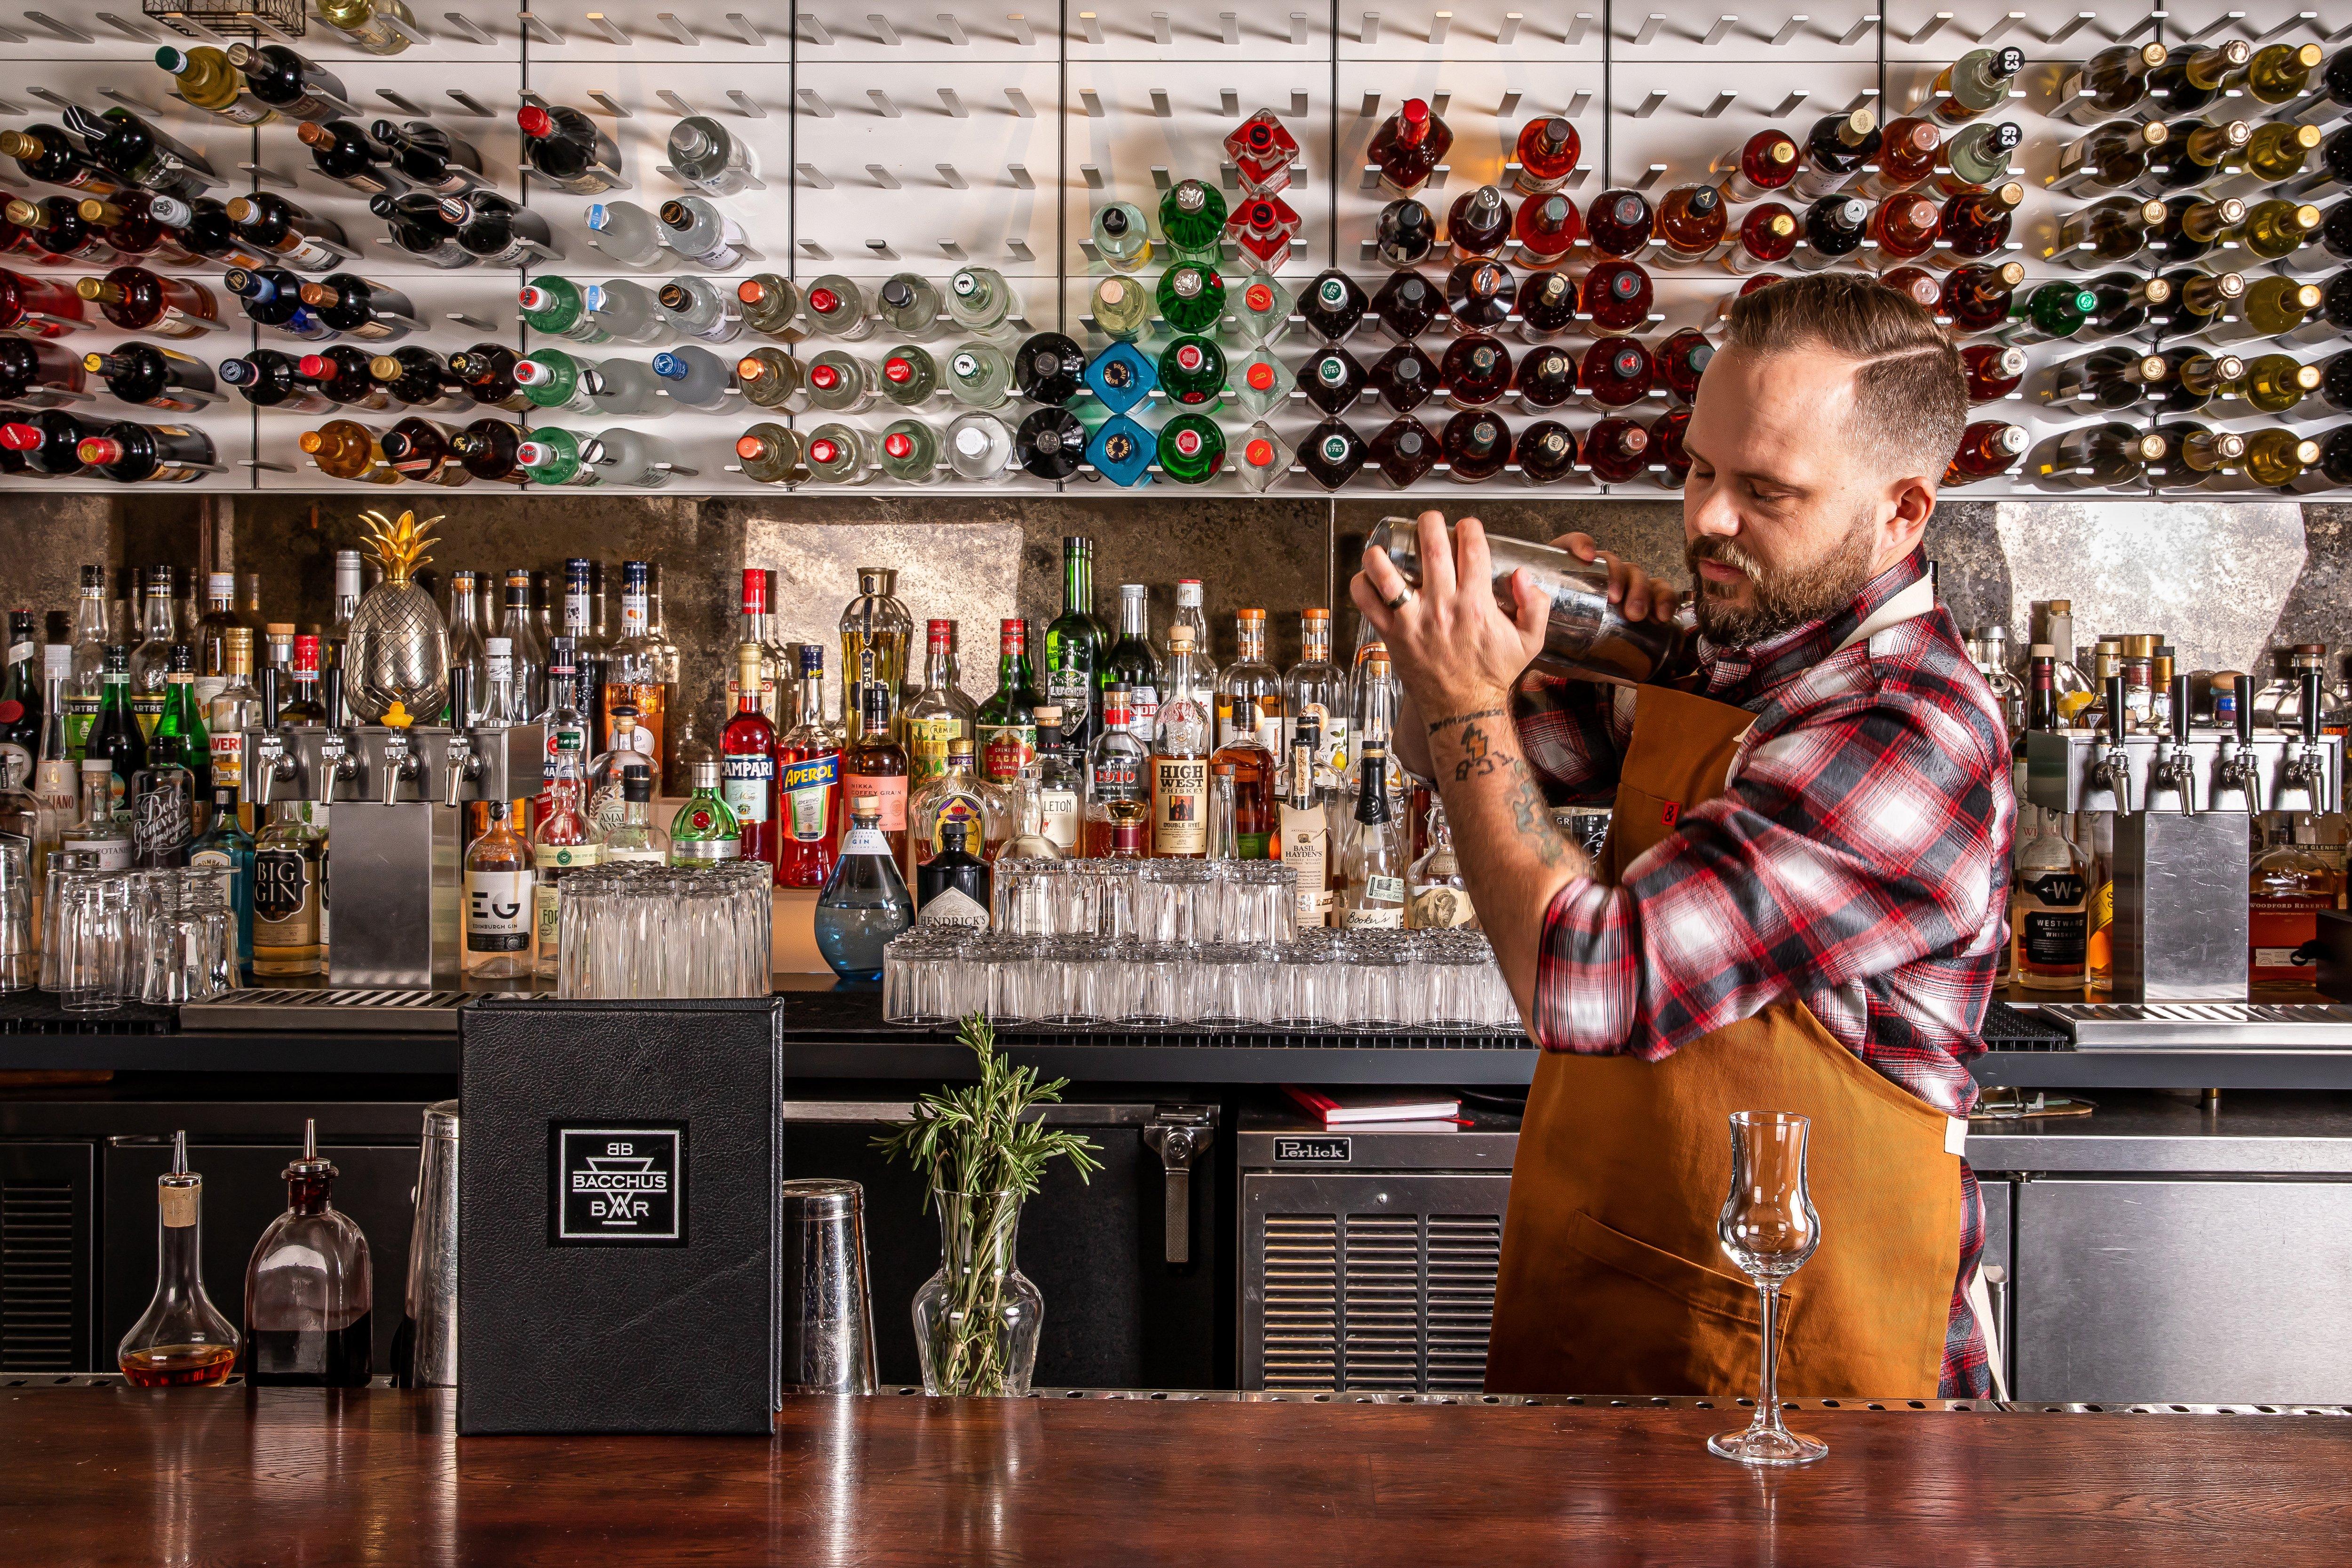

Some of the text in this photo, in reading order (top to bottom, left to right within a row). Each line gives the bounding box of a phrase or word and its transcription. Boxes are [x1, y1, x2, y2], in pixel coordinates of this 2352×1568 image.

[2004, 51, 2019, 70] 63
[2002, 126, 2017, 145] 63
[1329, 286, 1339, 299] 1783
[1113, 363, 1126, 380] BOMBAY
[1107, 437, 1118, 456] BOMBAY
[1118, 438, 1129, 458] BOMBAY
[1049, 686, 1087, 696] LUCID
[721, 761, 773, 777] CAMPARI
[785, 764, 834, 788] APEROL
[1095, 770, 1135, 783] 1910
[1160, 765, 1203, 779] HIGH
[1160, 779, 1203, 788] WEST
[141, 790, 181, 823] Bols
[1044, 799, 1072, 813] LETON
[257, 862, 296, 882] BIG
[255, 883, 297, 902] GIN
[2053, 881, 2071, 899] W
[472, 891, 520, 919] EG
[921, 915, 986, 926] HENDRICK'S
[1346, 912, 1391, 925] Booker's
[1279, 1142, 1344, 1158] Perlick
[572, 1174, 667, 1189] BACCHUS
[591, 1195, 649, 1218] BAR
